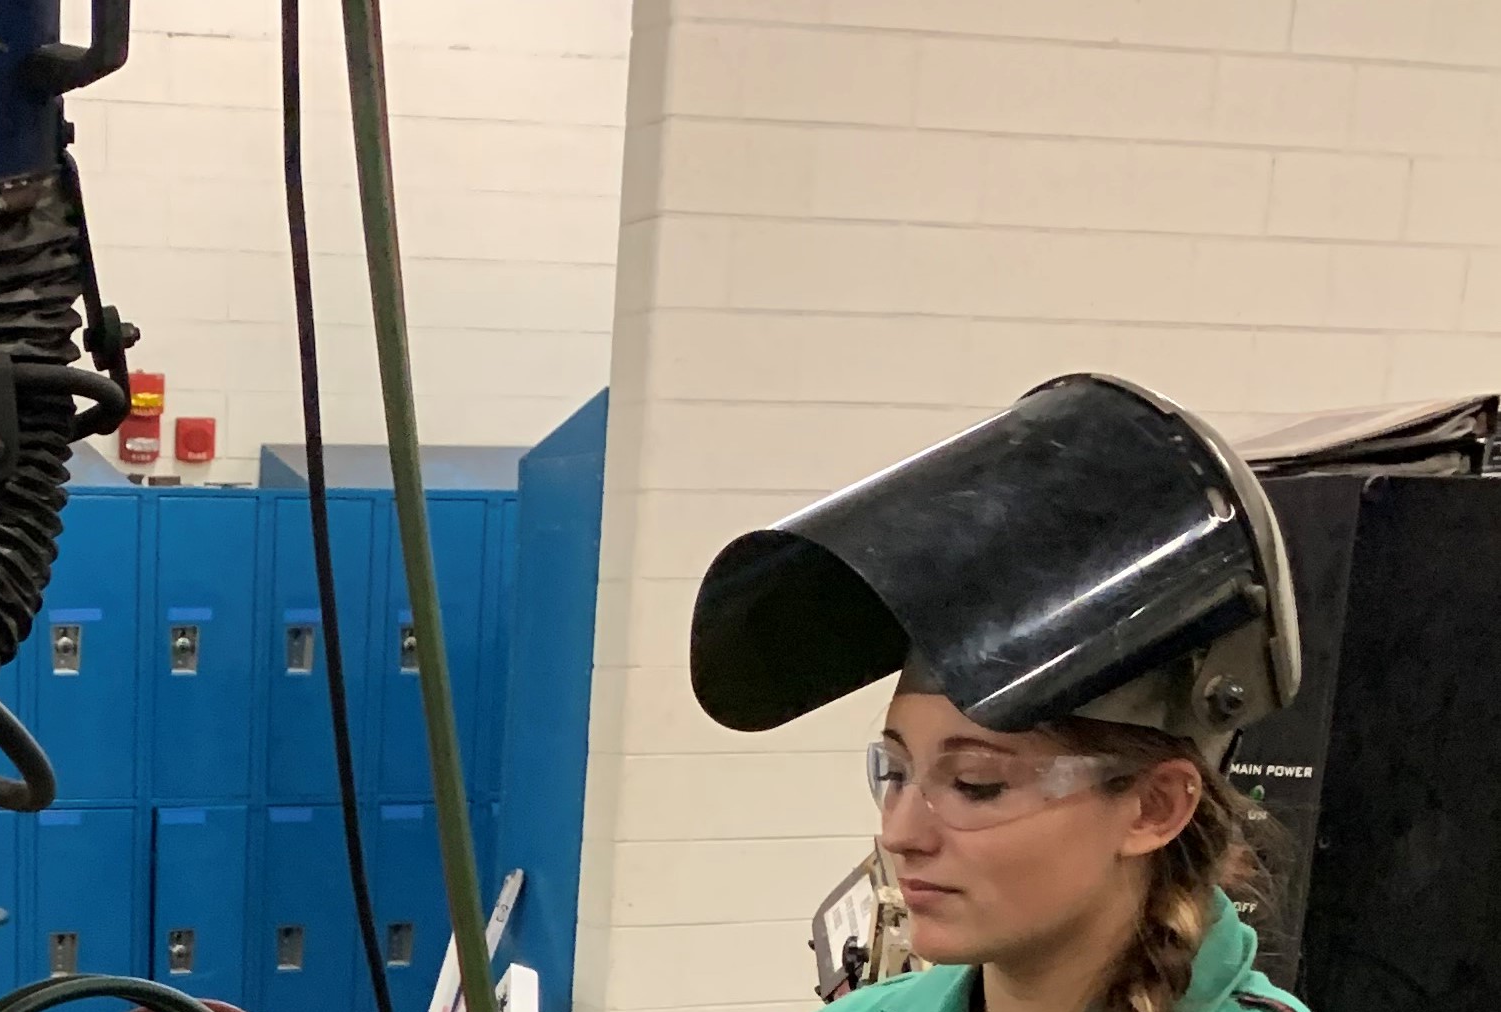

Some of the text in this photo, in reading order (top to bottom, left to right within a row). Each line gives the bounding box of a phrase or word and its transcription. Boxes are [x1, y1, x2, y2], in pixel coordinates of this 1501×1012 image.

[1229, 763, 1313, 778] MAIN POWER
[1233, 901, 1258, 913] OFF
